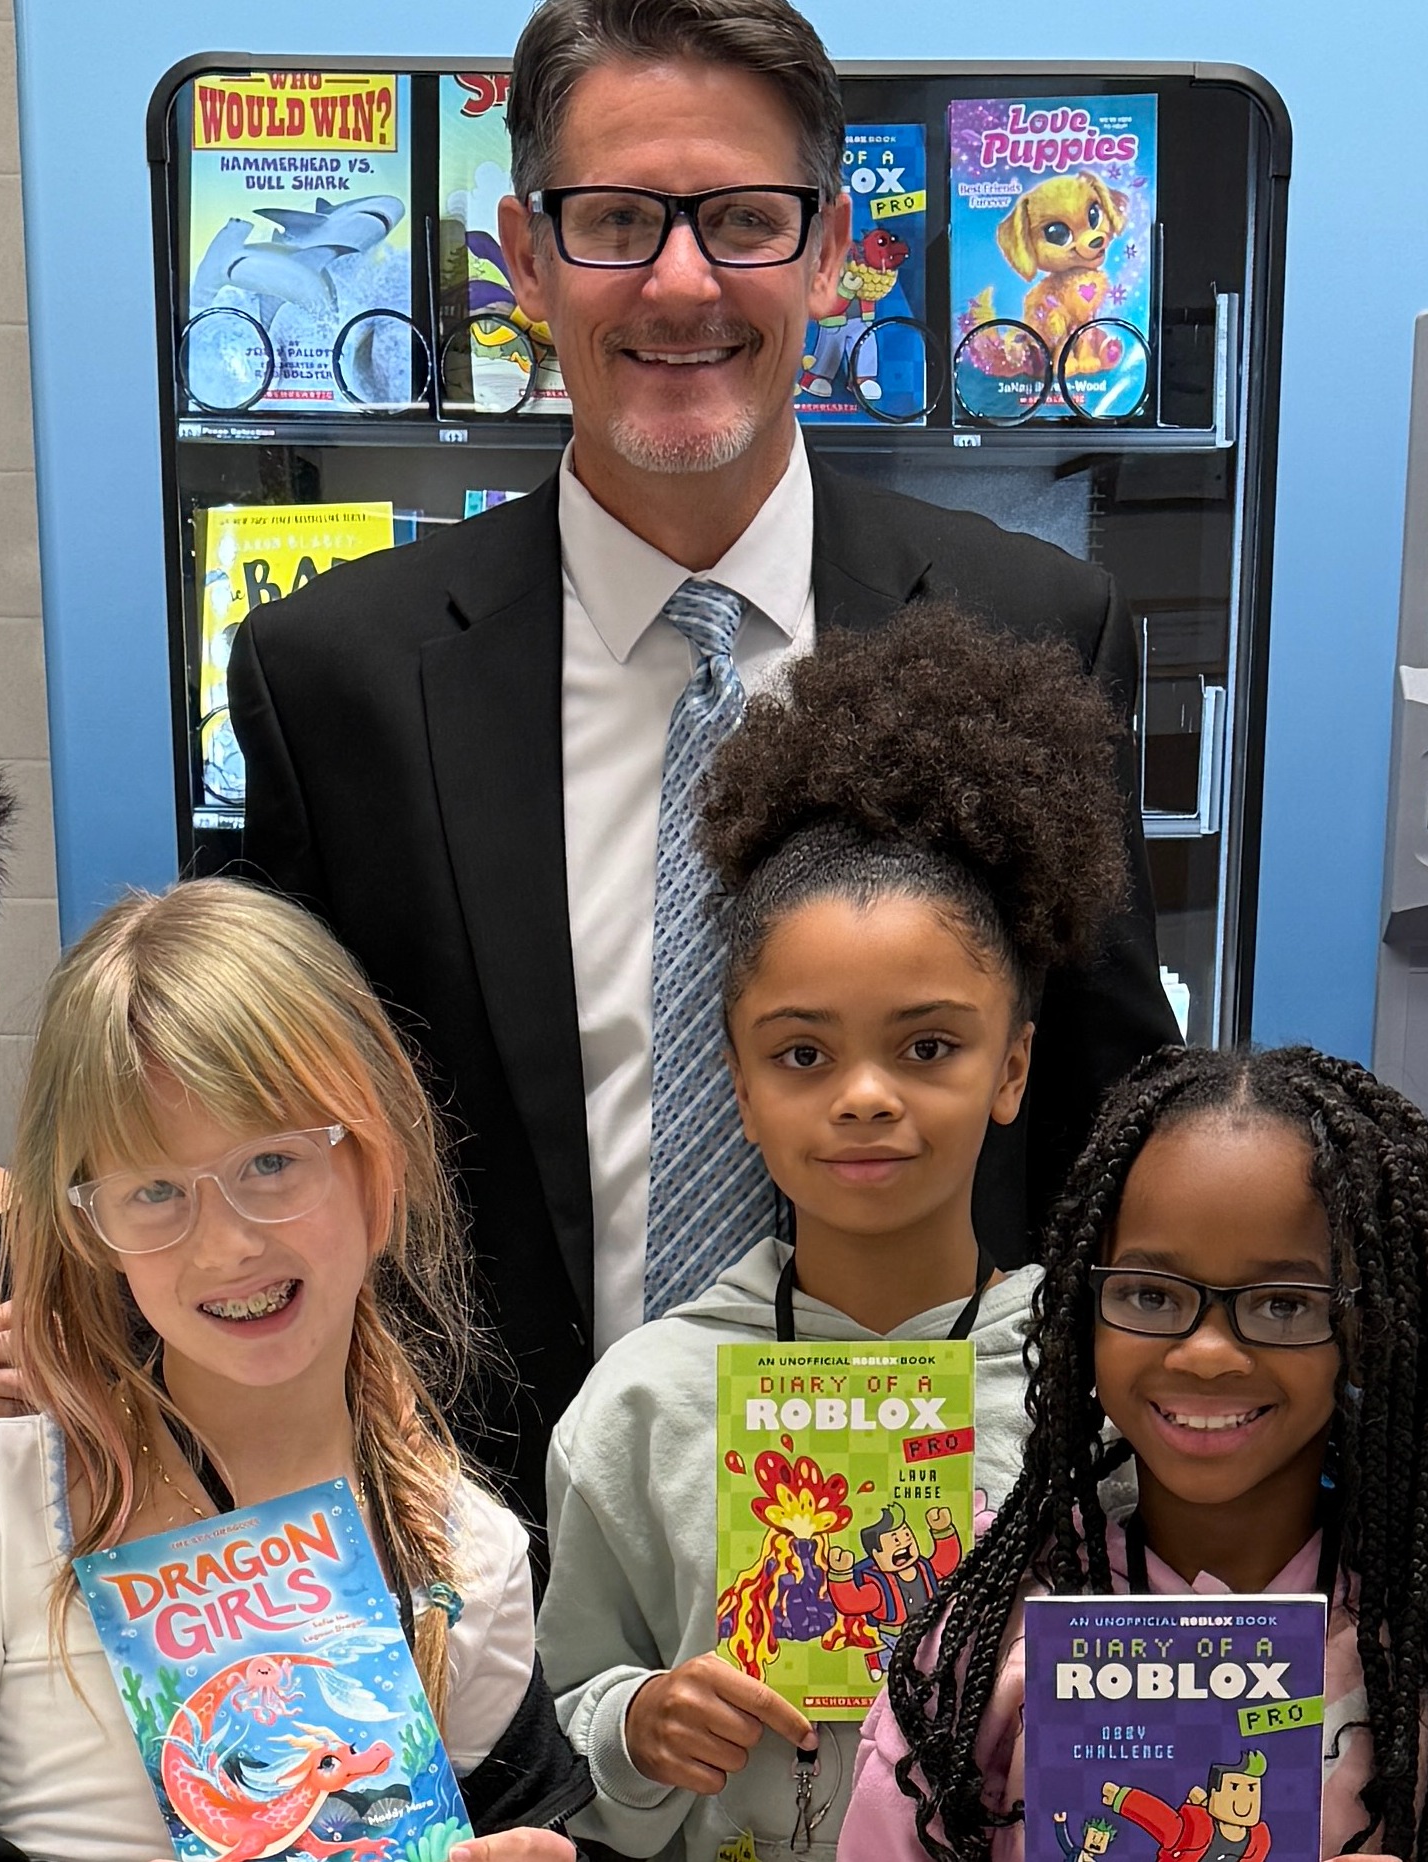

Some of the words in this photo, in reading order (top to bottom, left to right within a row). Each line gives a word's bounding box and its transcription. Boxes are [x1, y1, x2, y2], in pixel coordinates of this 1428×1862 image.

[198, 86, 306, 144] WOULD
[311, 87, 393, 145] WIN?
[1010, 105, 1090, 135] Love
[842, 150, 867, 165] OF
[882, 150, 894, 165] A
[982, 129, 1137, 172] Puppies
[221, 156, 341, 172] HAMMERHEAD
[348, 157, 375, 174] VS.
[245, 176, 285, 190] BULL
[291, 175, 350, 190] SHARK
[876, 196, 915, 215] PRO
[758, 1357, 775, 1366] AN
[779, 1356, 850, 1366] UNOFFICIAL
[900, 1356, 936, 1366] BOOK
[760, 1376, 848, 1394] DIARY
[867, 1375, 899, 1393] OF
[918, 1375, 932, 1393] A
[745, 1397, 947, 1431] ROBLOX
[909, 1436, 959, 1458] PRO
[898, 1469, 938, 1483] LAVA
[894, 1485, 942, 1499] CHASE
[100, 1512, 341, 1621] DRAGON
[154, 1567, 333, 1661] GIRLS
[1069, 1617, 1090, 1626] AN
[1095, 1616, 1177, 1626] UNOFFICIAL
[1180, 1616, 1233, 1627] ROBLOX
[1235, 1615, 1278, 1626] BOOK
[1072, 1637, 1174, 1658] DIARY
[1197, 1637, 1233, 1658] OF
[1256, 1637, 1273, 1657] A
[1056, 1662, 1291, 1700] ROBLOX
[815, 1697, 875, 1706] SCHOLAST
[1246, 1704, 1304, 1730] PRO
[1101, 1726, 1146, 1741] OBBY
[1073, 1744, 1175, 1759] CHALLENGE
